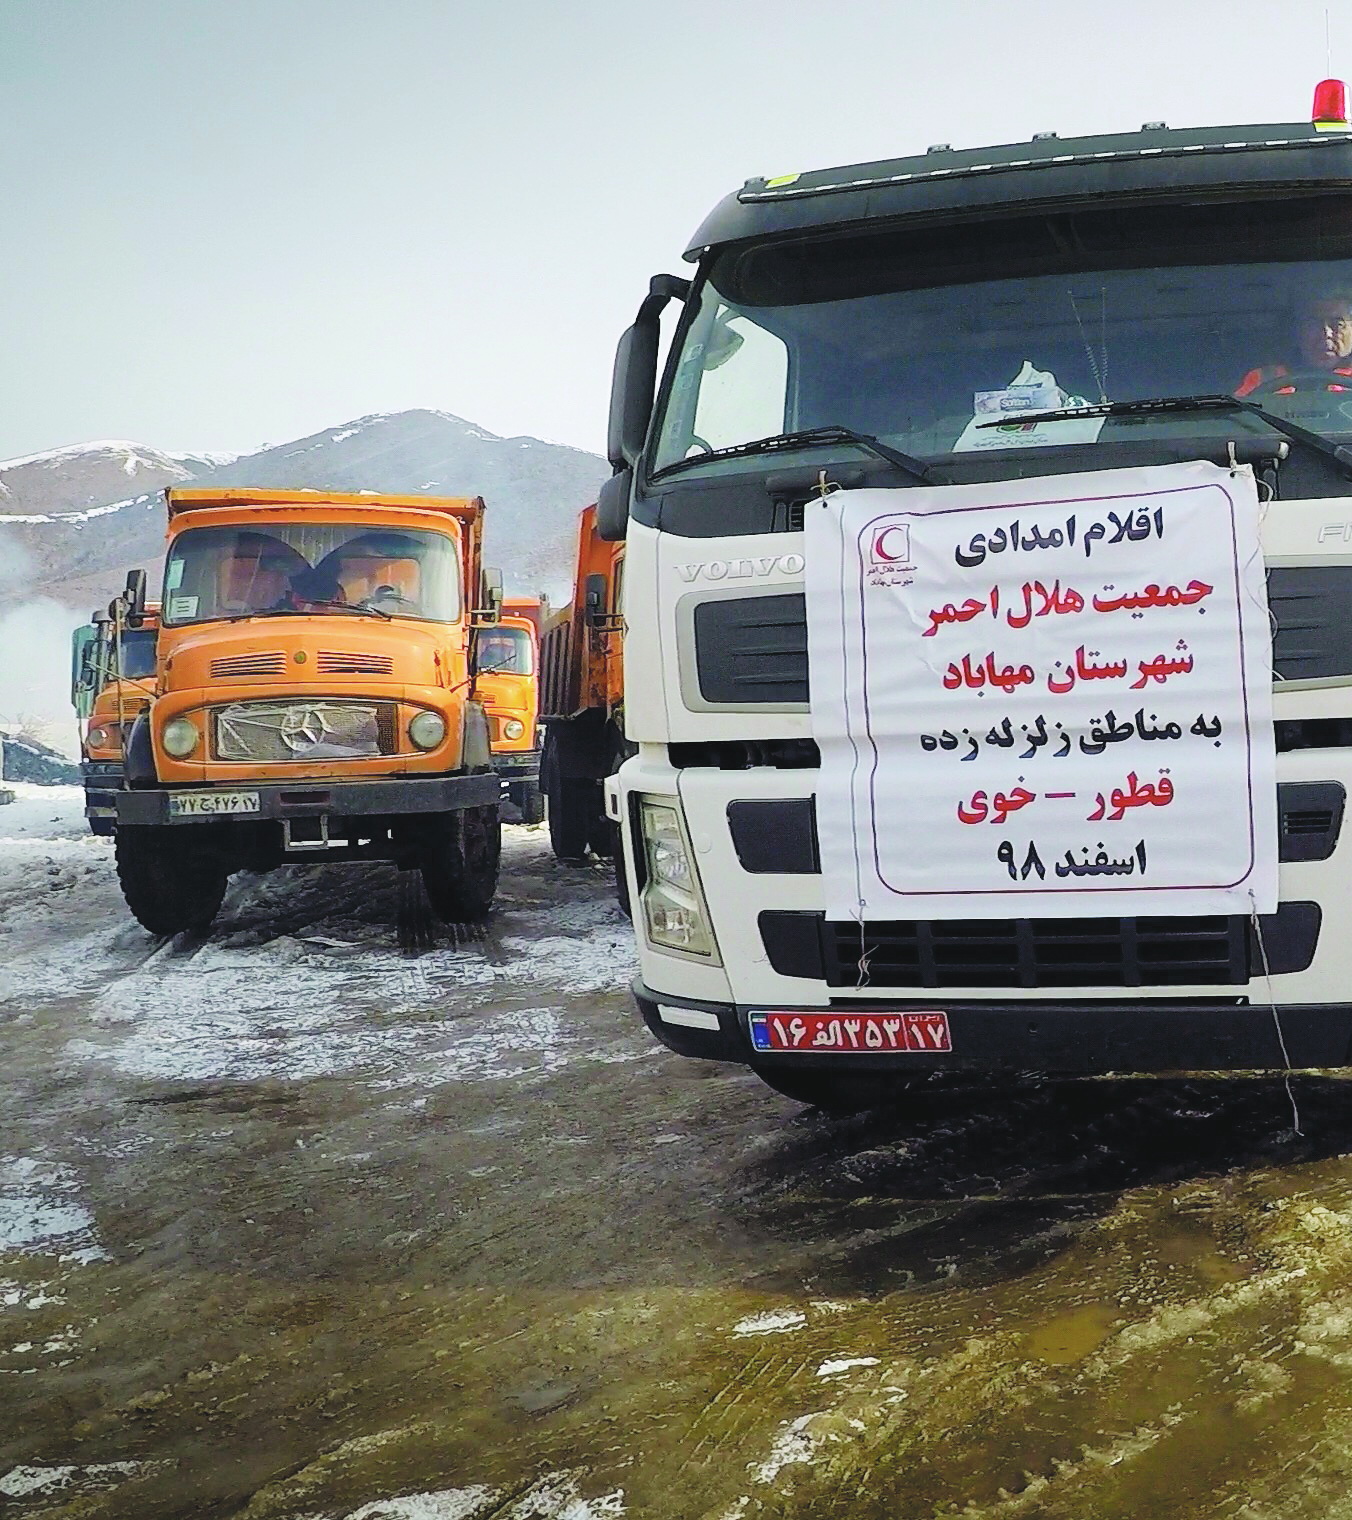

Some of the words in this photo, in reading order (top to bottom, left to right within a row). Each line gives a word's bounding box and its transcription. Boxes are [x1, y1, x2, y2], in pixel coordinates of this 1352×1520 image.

[954, 515, 1075, 567] امدادی
[1084, 507, 1163, 557] اقلام
[673, 552, 805, 583] VOLVO
[922, 585, 998, 636] احمر
[1007, 580, 1084, 628] هلال
[1093, 580, 1213, 619] جمعیت
[943, 652, 1034, 697] مهاباد
[1080, 708, 1182, 755] مناطق
[1190, 714, 1221, 747] به
[958, 776, 1036, 824] خوی
[1087, 769, 1174, 821] قطور
[998, 841, 1045, 880] ۹۸
[1055, 839, 1146, 877] اسفند
